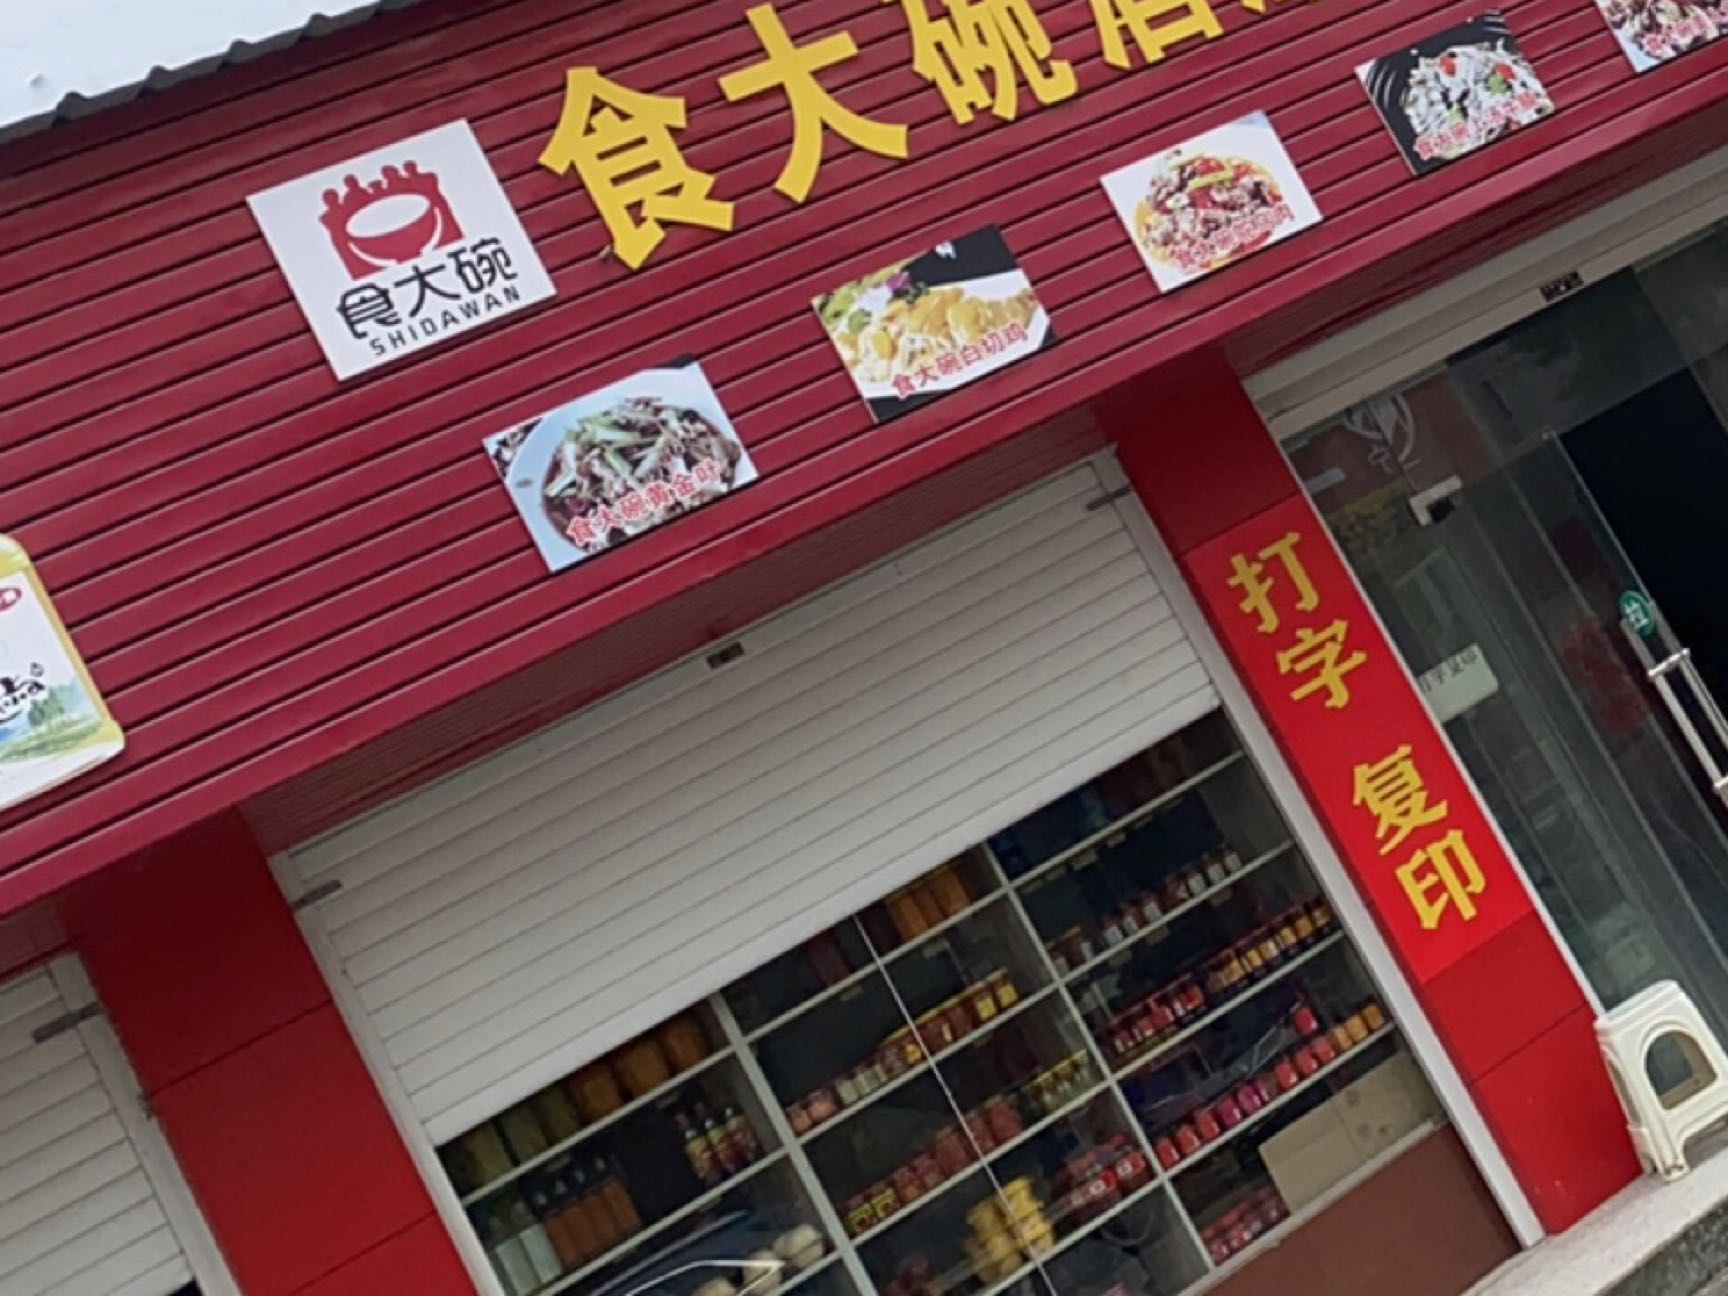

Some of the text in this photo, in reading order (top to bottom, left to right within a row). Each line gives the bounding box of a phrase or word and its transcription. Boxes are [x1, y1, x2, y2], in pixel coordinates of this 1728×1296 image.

[336, 236, 521, 339] 食大碗
[369, 284, 521, 357] SHIDAWAN
[890, 319, 1031, 403] 食大碗白切鸡
[1225, 531, 1488, 933] 打字 复印
